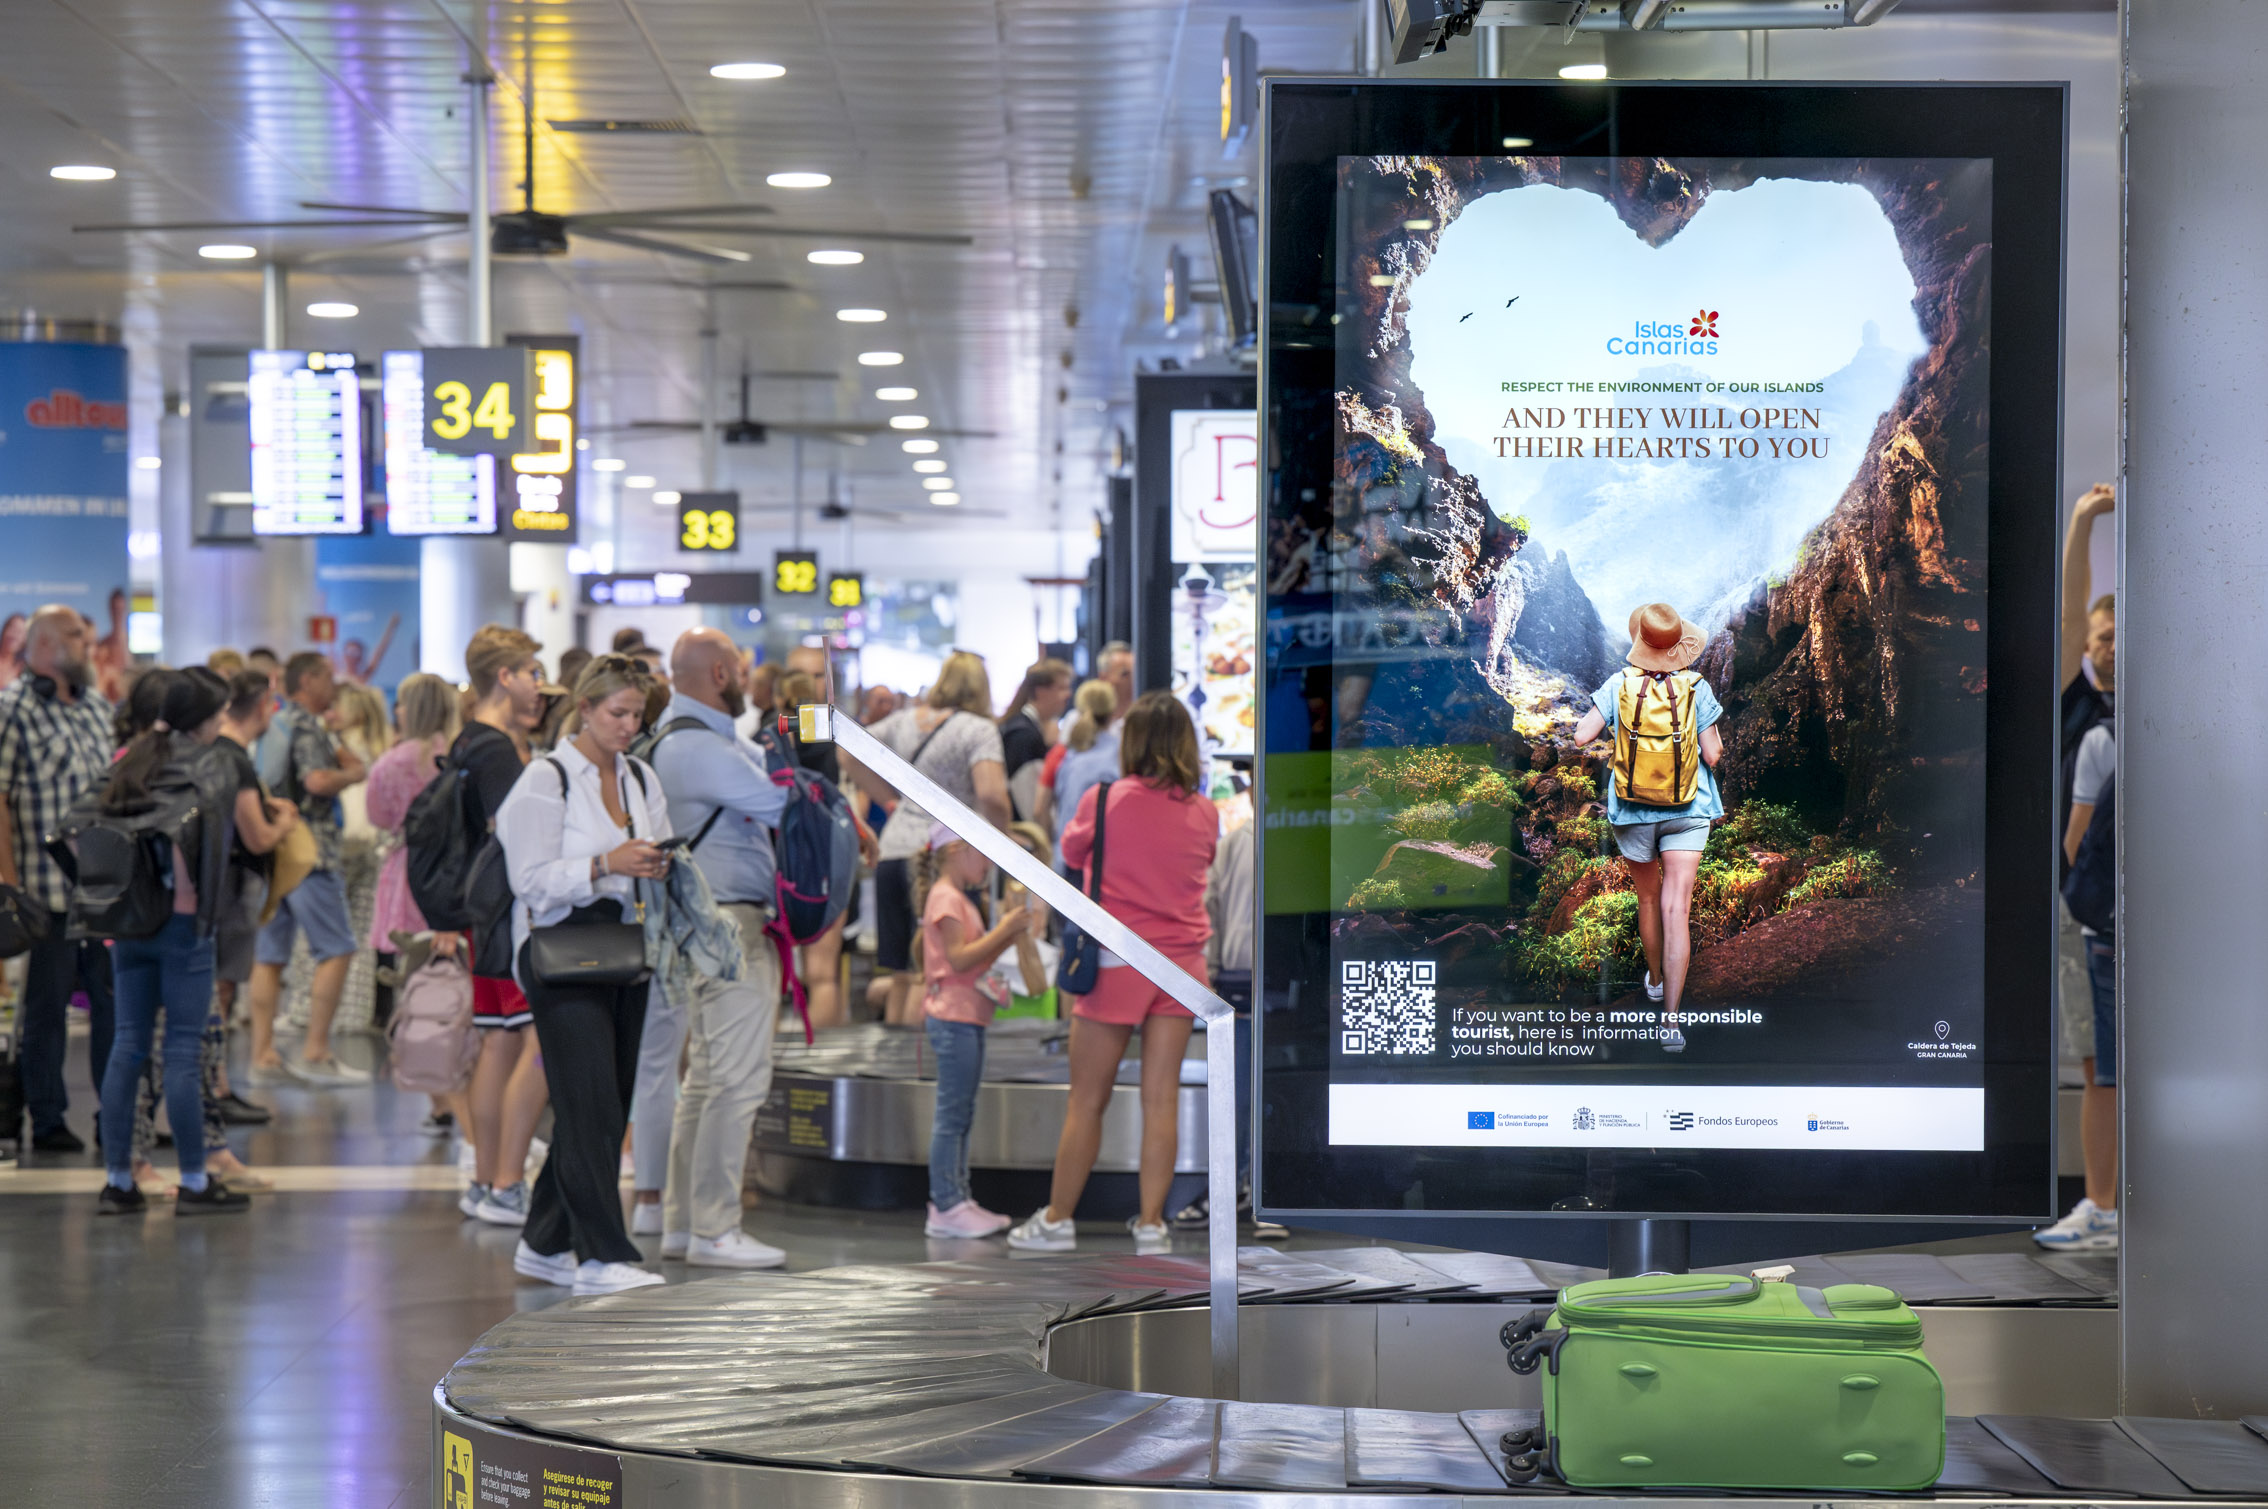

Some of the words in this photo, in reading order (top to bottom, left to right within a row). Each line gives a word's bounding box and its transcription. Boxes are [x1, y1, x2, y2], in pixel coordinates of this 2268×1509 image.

[1635, 321, 1684, 338] Islas
[1606, 337, 1718, 355] Canarias
[1501, 382, 1563, 393] RESPECT
[1567, 382, 1594, 393] THE
[1598, 382, 1702, 393] ENVIRONMENT
[1706, 382, 1725, 393] OF
[1729, 382, 1759, 393] OUR
[1764, 382, 1824, 393] ISLANDS
[431, 380, 516, 440] 34
[1501, 407, 1566, 429] AND
[1574, 407, 1653, 429] THEY
[1659, 407, 1732, 429] WILL
[1740, 407, 1822, 429] OPEN
[1493, 437, 1585, 458] THEIR
[1593, 437, 1711, 458] HEARTS
[1719, 437, 1759, 458] TO
[1767, 437, 1830, 458] YOU
[682, 509, 735, 549] 33
[776, 560, 816, 593] 32
[1453, 1008, 1464, 1022] If
[1466, 1011, 1497, 1025] you
[1501, 1010, 1544, 1022] want
[1549, 1010, 1566, 1022] to
[1570, 1009, 1592, 1023] be
[1595, 1012, 1605, 1022] a
[1610, 1011, 1656, 1023] more
[1661, 1009, 1762, 1026] responsible
[1452, 1024, 1514, 1041] tourist,
[1519, 1025, 1556, 1039] here
[1561, 1025, 1574, 1039] is
[1582, 1025, 1681, 1040] information
[1451, 1044, 1482, 1058] you
[1486, 1041, 1543, 1055] should
[1549, 1042, 1595, 1056] know
[1907, 1042, 1938, 1050] Caldera
[1950, 1043, 1977, 1051] Tejeda
[1698, 1116, 1733, 1126] Fondos
[1734, 1116, 1778, 1128] Europeos
[481, 1460, 494, 1475] Ensure
[494, 1465, 503, 1477] that
[503, 1470, 511, 1480] you
[512, 1470, 528, 1483] collect
[543, 1468, 575, 1484] Asegúrese
[576, 1474, 585, 1486] de
[586, 1478, 613, 1491] recoger
[488, 1477, 500, 1490] check
[510, 1483, 531, 1499] baggage
[543, 1484, 548, 1496] y
[548, 1485, 570, 1497] revisar
[571, 1490, 580, 1499] su
[581, 1491, 611, 1506] equipaje
[543, 1498, 560, 1509] antes
[561, 1500, 570, 1509] de
